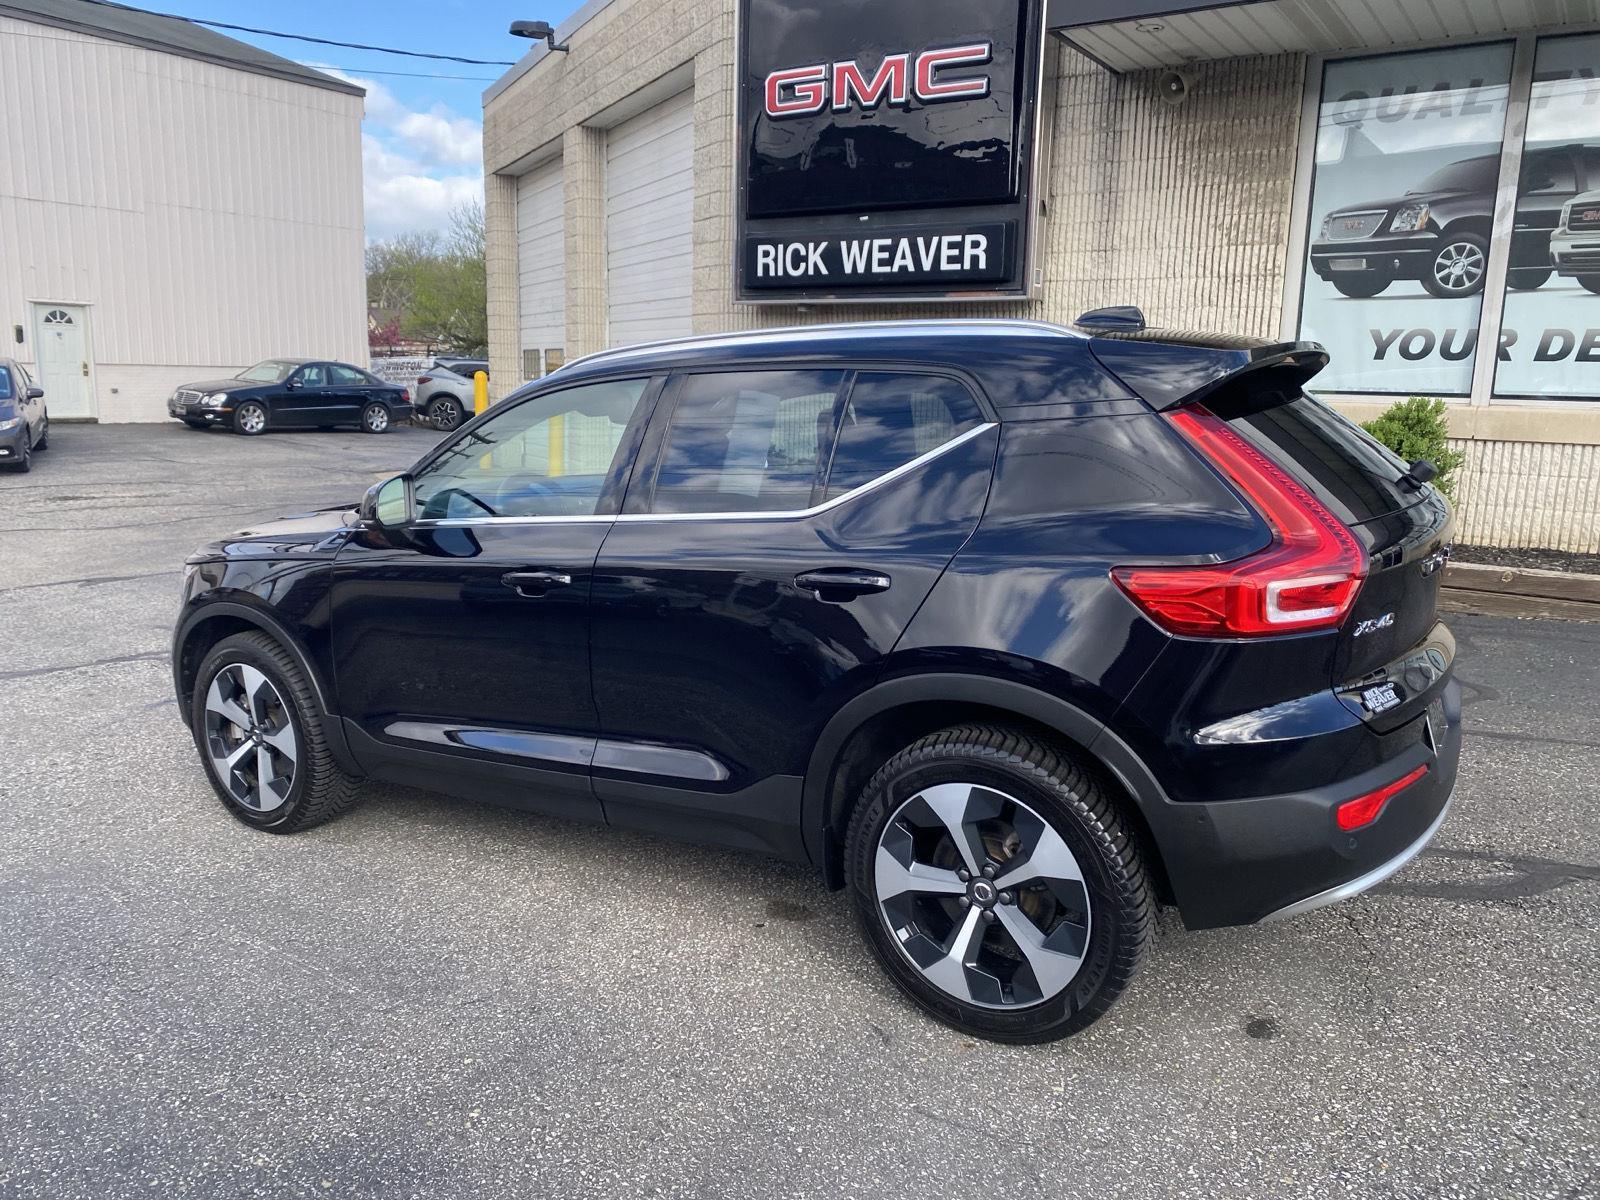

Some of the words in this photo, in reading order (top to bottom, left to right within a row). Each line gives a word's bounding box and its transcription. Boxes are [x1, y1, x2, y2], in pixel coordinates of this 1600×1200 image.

[764, 40, 992, 118] GMC
[1332, 67, 1600, 129] QUALTY
[756, 241, 829, 277] RICK
[841, 234, 988, 274] WEAVER
[1368, 328, 1518, 362] YOUR
[1362, 686, 1378, 700] RICK
[1365, 689, 1397, 709] WEAVER
